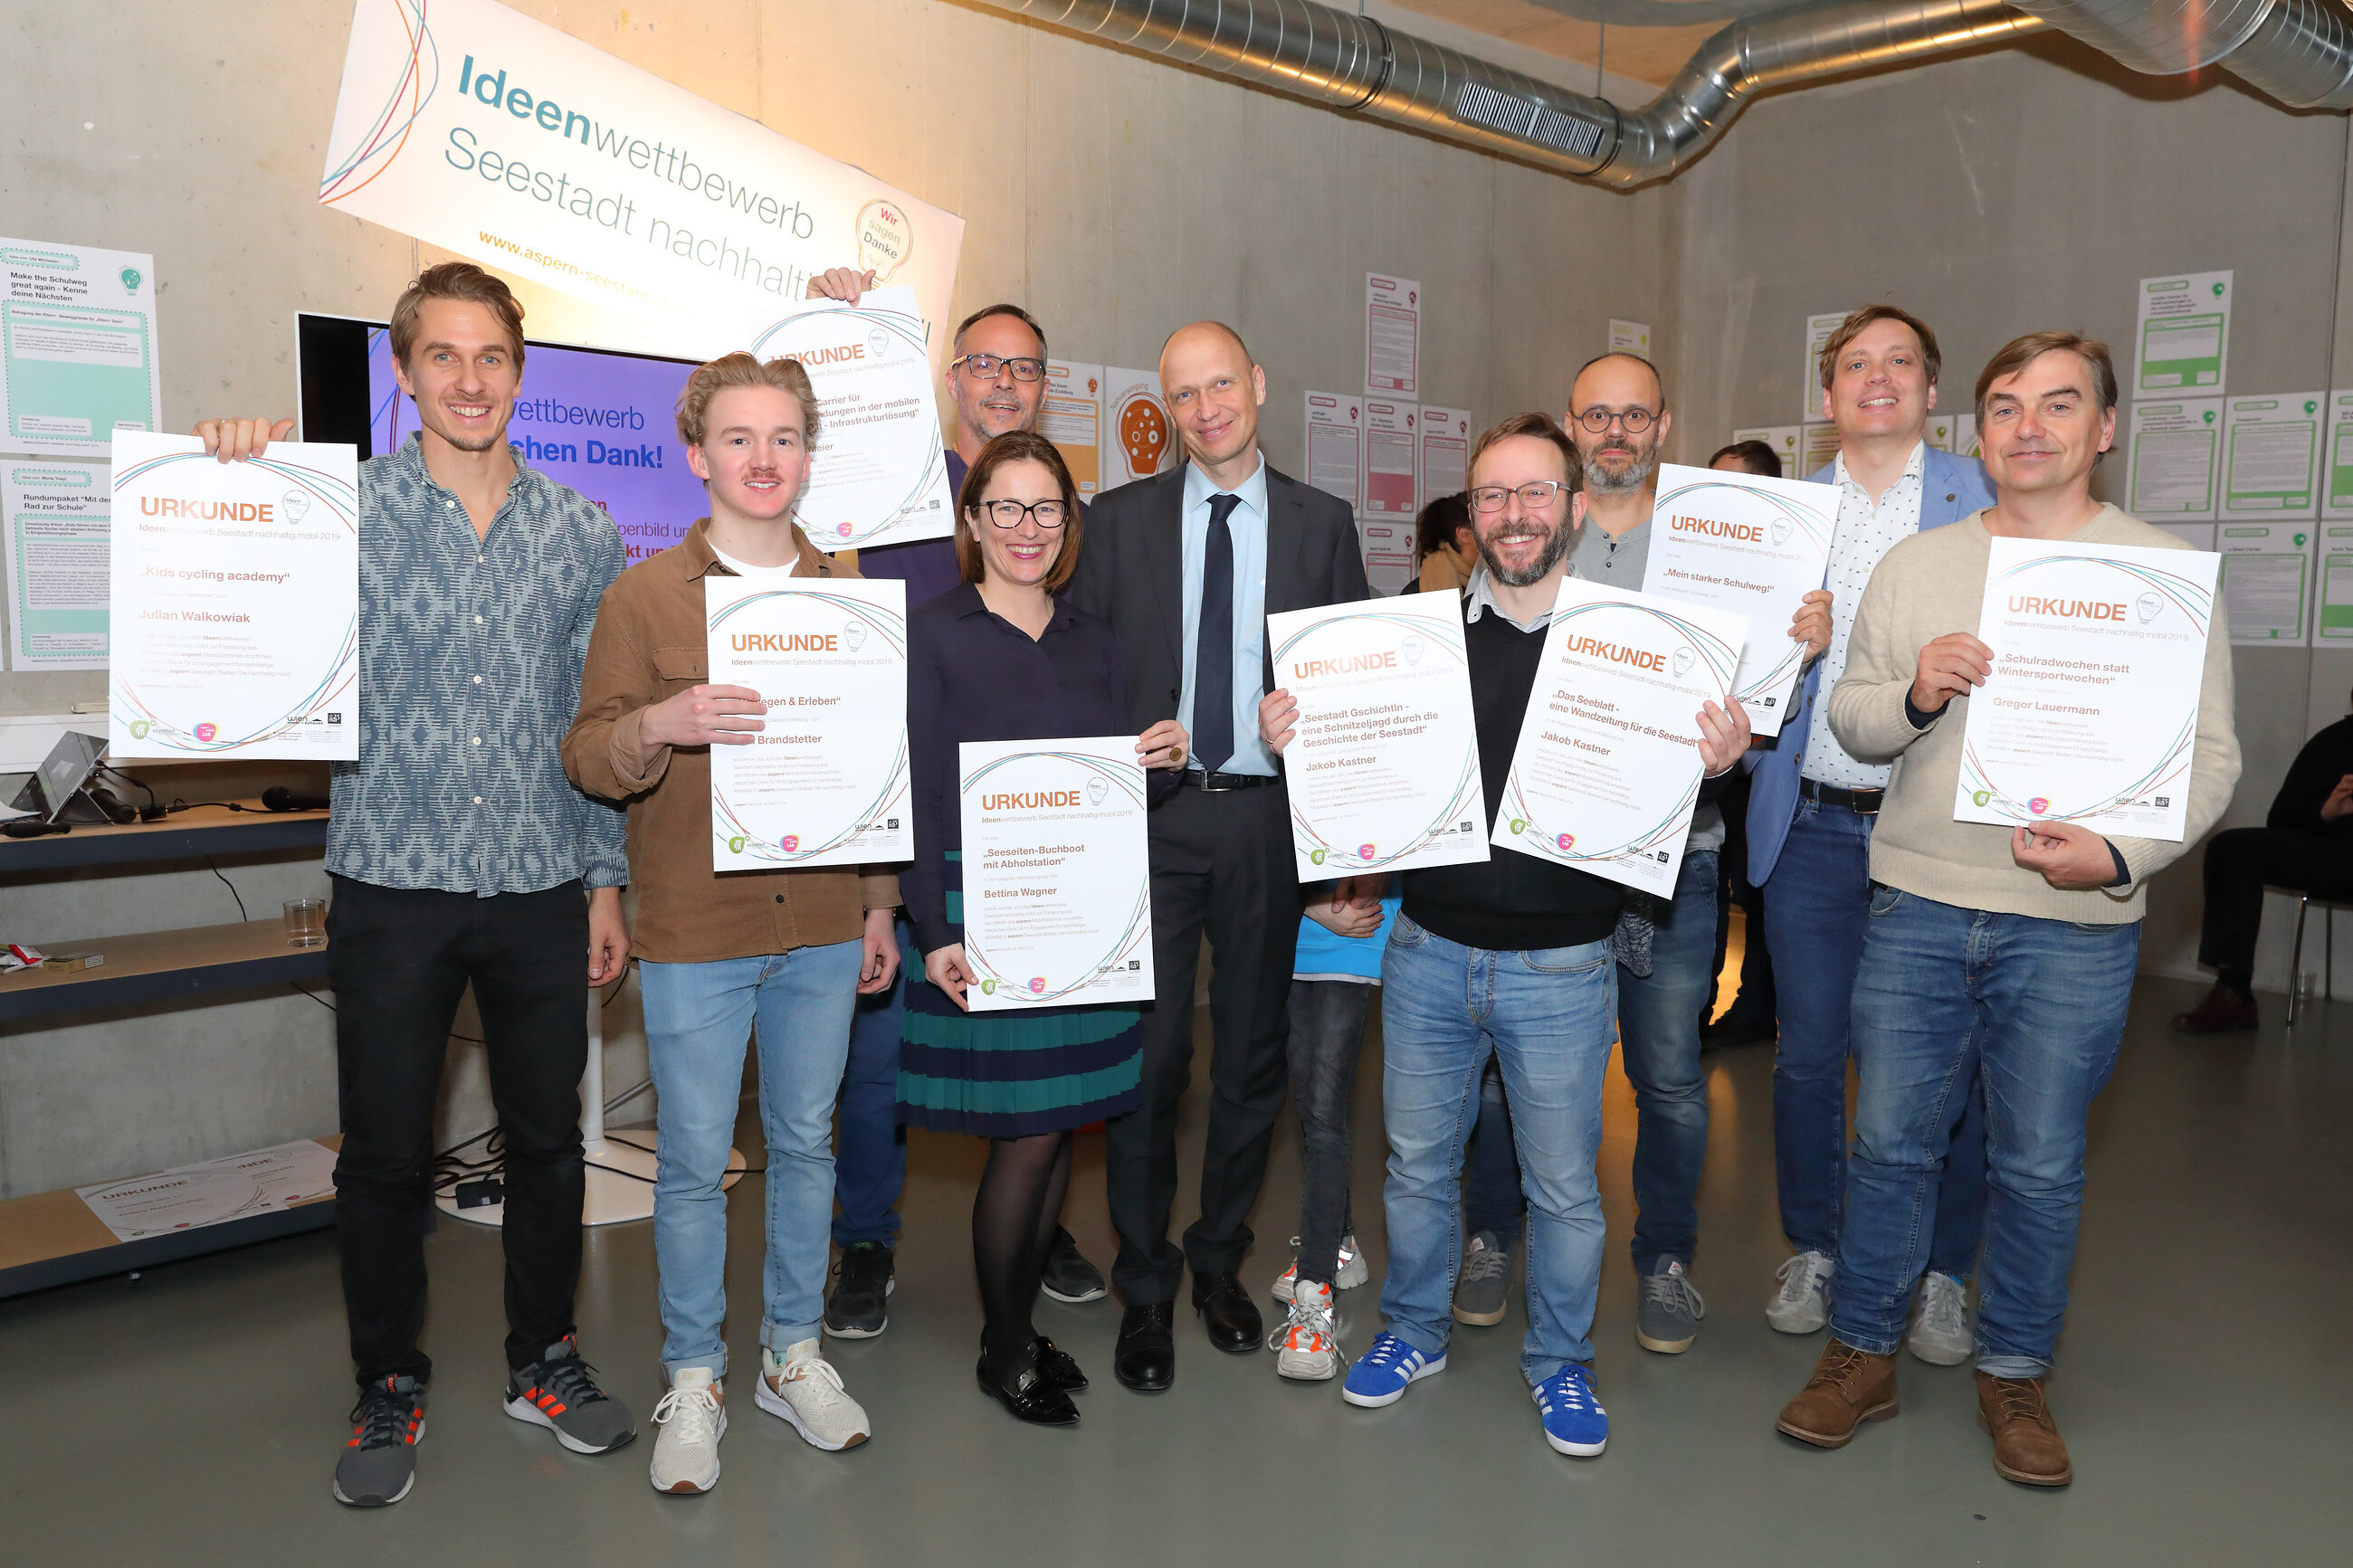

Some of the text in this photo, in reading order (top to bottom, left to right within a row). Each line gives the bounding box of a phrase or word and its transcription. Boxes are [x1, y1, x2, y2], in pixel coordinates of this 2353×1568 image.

[458, 54, 814, 240] Ideenwettbewerb
[444, 127, 813, 302] Seestadt nachhalt
[881, 207, 899, 225] Wir
[869, 219, 900, 245] sagen
[863, 231, 898, 259] Danke
[10, 271, 88, 287] Make the Schulweg
[10, 280, 33, 290] great
[33, 283, 56, 291] again
[62, 285, 88, 295] Kenne
[11, 290, 73, 301] deine Nächsten
[848, 394, 861, 404] für
[857, 397, 920, 413] in der mobilen
[586, 440, 662, 469] Dank!
[24, 493, 79, 502] Rundumpaket
[140, 496, 274, 523] URKUNDE
[216, 527, 253, 537] Seestadt
[255, 530, 296, 541] nachhaltig
[297, 531, 319, 540] mobil
[319, 532, 340, 541] 2019
[1671, 514, 1764, 543] URKUNDE
[1668, 535, 1720, 549] Ideenwettbewerb
[1719, 542, 1747, 553] Seestadt
[1745, 547, 1778, 559] nachhaltig
[146, 566, 291, 584] „Kids cycling academy“
[1662, 567, 1691, 579] „Mein
[1690, 572, 1723, 584] starker
[1722, 577, 1775, 594] Schulweg!“
[140, 609, 251, 623] Julian Walkowiak
[2008, 595, 2128, 622] URKUNDE
[2004, 619, 2189, 641] Ideenwettbewerb Seestadt nachhaltig mobil 2019
[731, 633, 838, 652] URKUNDE
[731, 658, 892, 668] Ideenwettbewerb Seestadt nachhaltig mobil 2019
[1567, 633, 1667, 673] URKUNDE
[1293, 651, 1397, 681] URKUNDE
[1999, 653, 2130, 674] „Schulradwochen statt
[1561, 656, 1711, 702] Ideenwettbewerb Seestadt nachhaltig mobil 2019
[1997, 666, 2116, 685] Wintersportwochen“
[788, 696, 842, 706] & Erleben“
[1551, 689, 1576, 702] „Das
[1576, 694, 1615, 712] Seeblatt
[1993, 697, 2101, 716] Gregor Lauermann
[1300, 709, 1349, 725] „Seestadt
[1301, 711, 1439, 736] eine Schnitzeljagd durch die
[1548, 701, 1569, 714] eine
[1570, 706, 1629, 731] Wandzeitung
[1629, 721, 1643, 733] für
[1643, 726, 1657, 736] die
[757, 735, 823, 745] Brandstetter
[1302, 724, 1427, 748] Geschichte der Seestadt“
[1540, 730, 1572, 746] Jakob
[1572, 738, 1612, 756] Kastner
[1306, 755, 1377, 772] Jakob Kastner
[982, 790, 1081, 811] URKUNDE
[981, 809, 1133, 825] Ideenwettbewerb Seestadt nachhaltig mobil 2019
[983, 843, 1085, 860] „Seeseiten-Buchboot
[983, 856, 1066, 870] mit Abholstation“
[984, 888, 1058, 898] Bettina Wagner
[102, 1180, 189, 1201] URKUNDE
